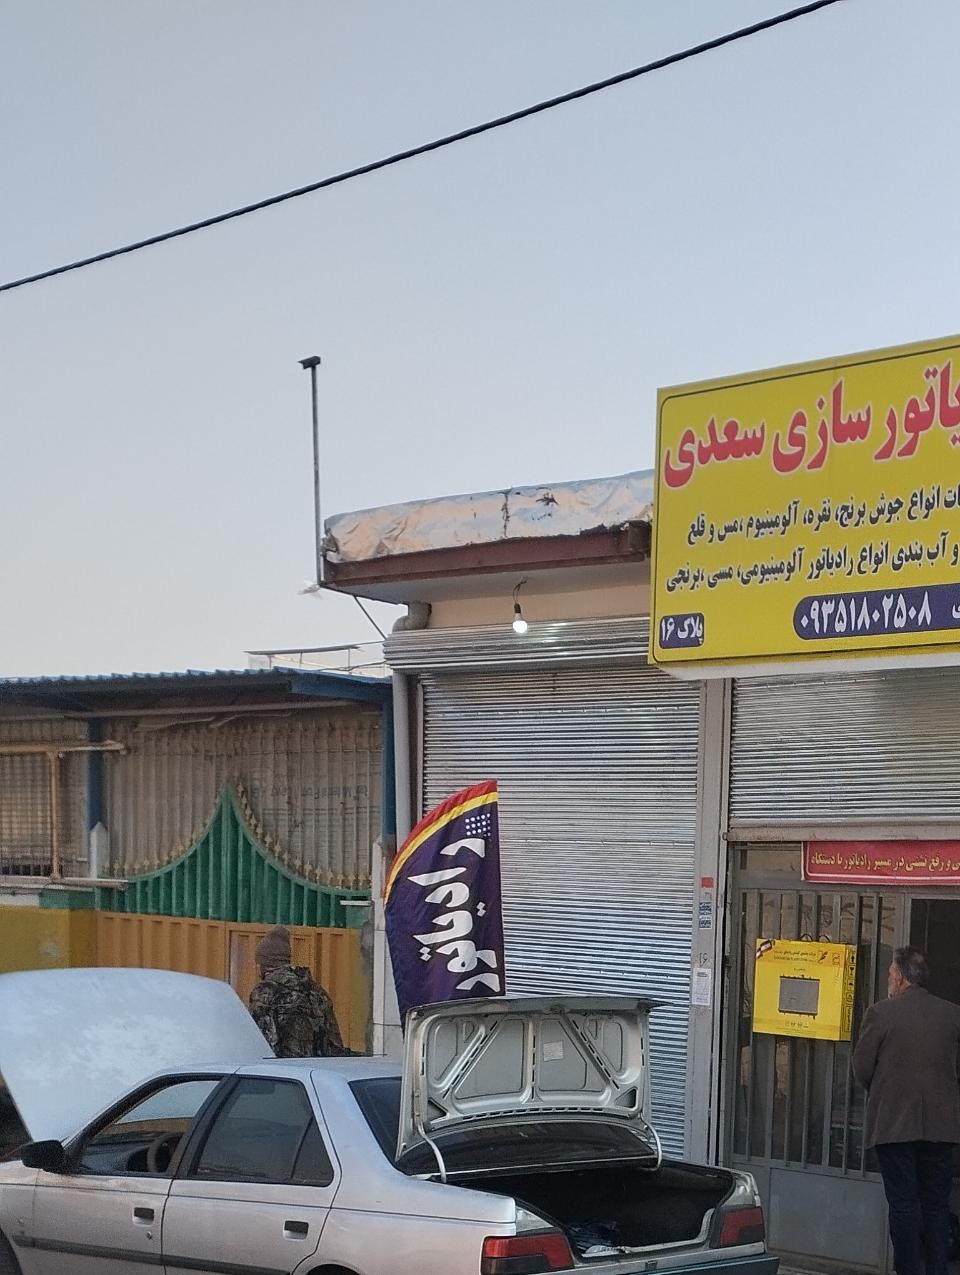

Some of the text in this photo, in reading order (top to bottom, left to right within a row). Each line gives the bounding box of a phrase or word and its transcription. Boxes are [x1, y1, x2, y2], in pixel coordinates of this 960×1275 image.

[772, 378, 871, 473] سازی
[663, 415, 766, 488] سعدی
[869, 493, 904, 524] جوش
[907, 485, 941, 520] انواع
[687, 513, 706, 545] قلع
[707, 523, 715, 543] و
[746, 500, 799, 538] آلومینیوم
[806, 546, 854, 579] رادیاتور
[856, 540, 889, 575] انواع
[891, 541, 923, 571] بندی
[926, 531, 948, 566] آب
[950, 543, 959, 566] و
[707, 565, 733, 588] مسی
[800, 590, 932, 634] ۰۹۳۵۱۸۰۲۵۰۸
[661, 616, 703, 645] پلاک ۱۶
[843, 853, 871, 870] رادیاتور
[893, 856, 905, 871] در
[407, 838, 501, 993] رادیاتور
